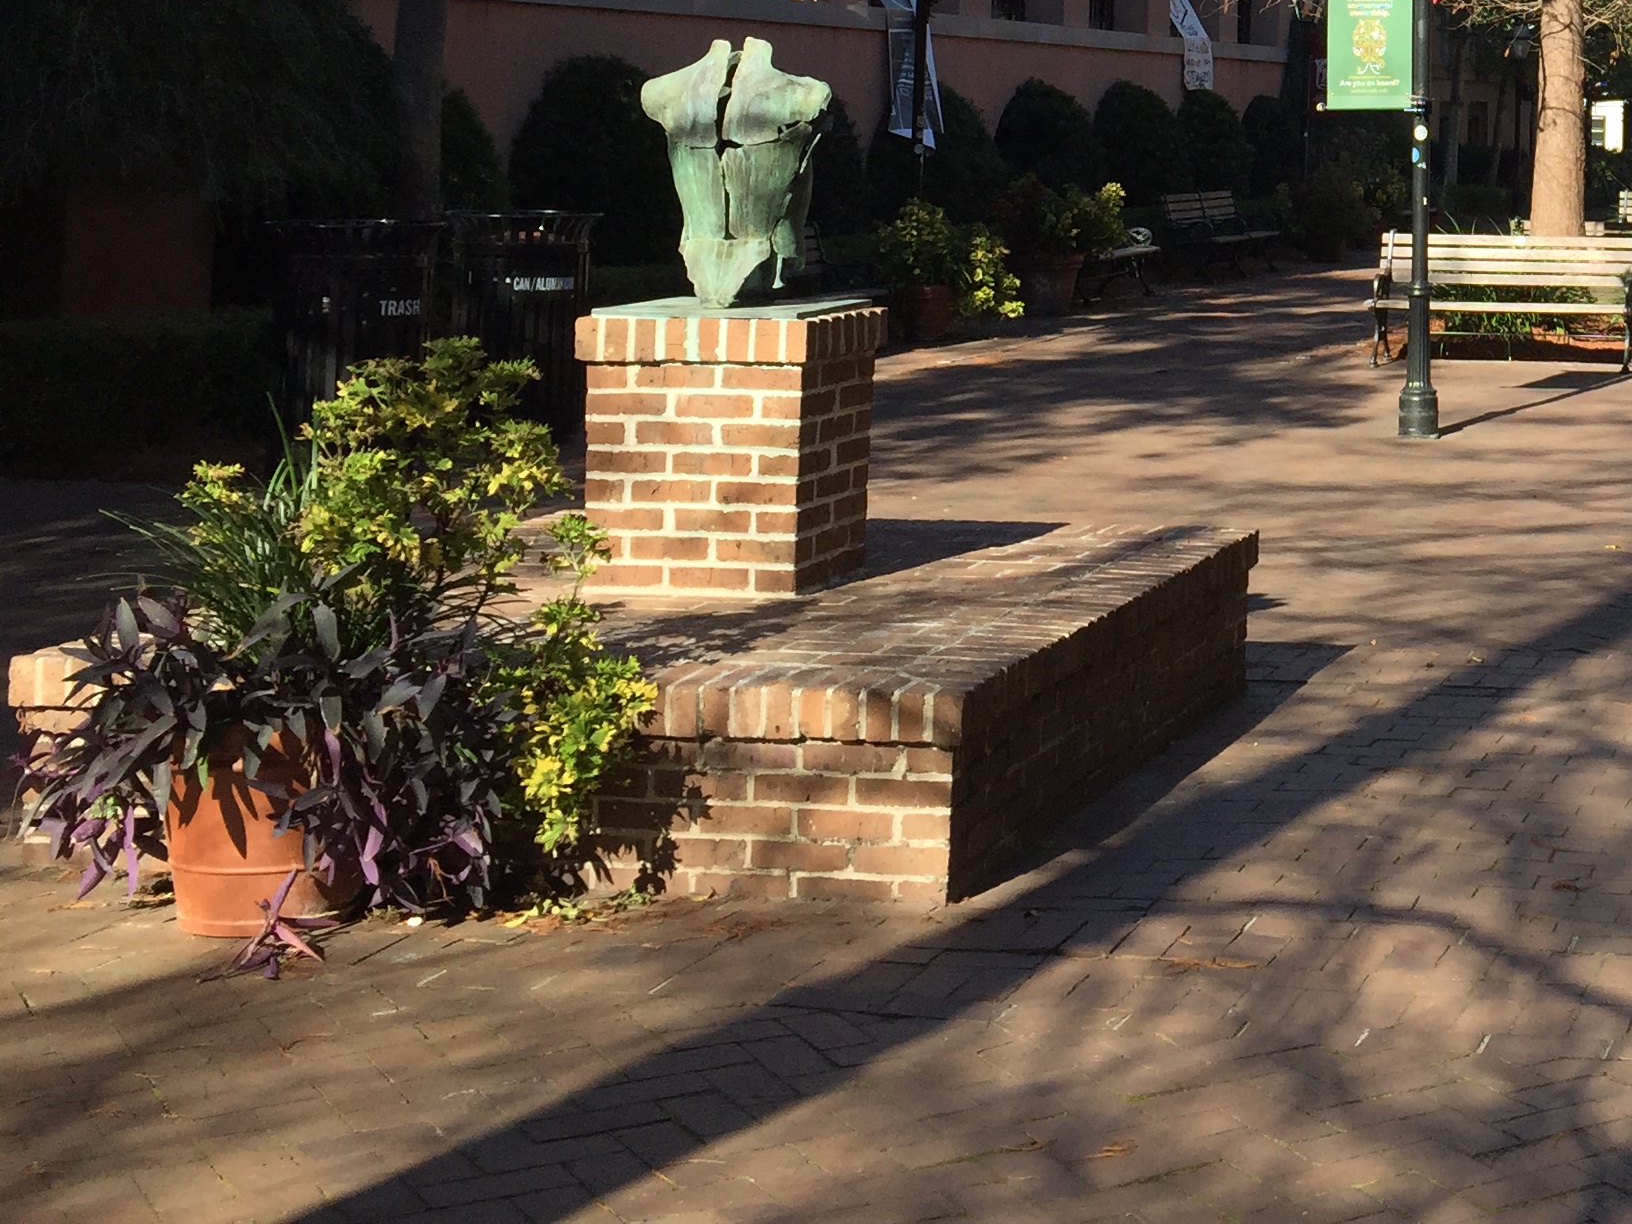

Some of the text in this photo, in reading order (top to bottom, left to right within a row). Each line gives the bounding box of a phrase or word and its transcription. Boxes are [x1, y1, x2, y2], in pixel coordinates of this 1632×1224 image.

[1339, 79, 1352, 87] Are
[1352, 80, 1366, 88] you
[1376, 79, 1400, 87] board?
[379, 298, 421, 316] TRASH
